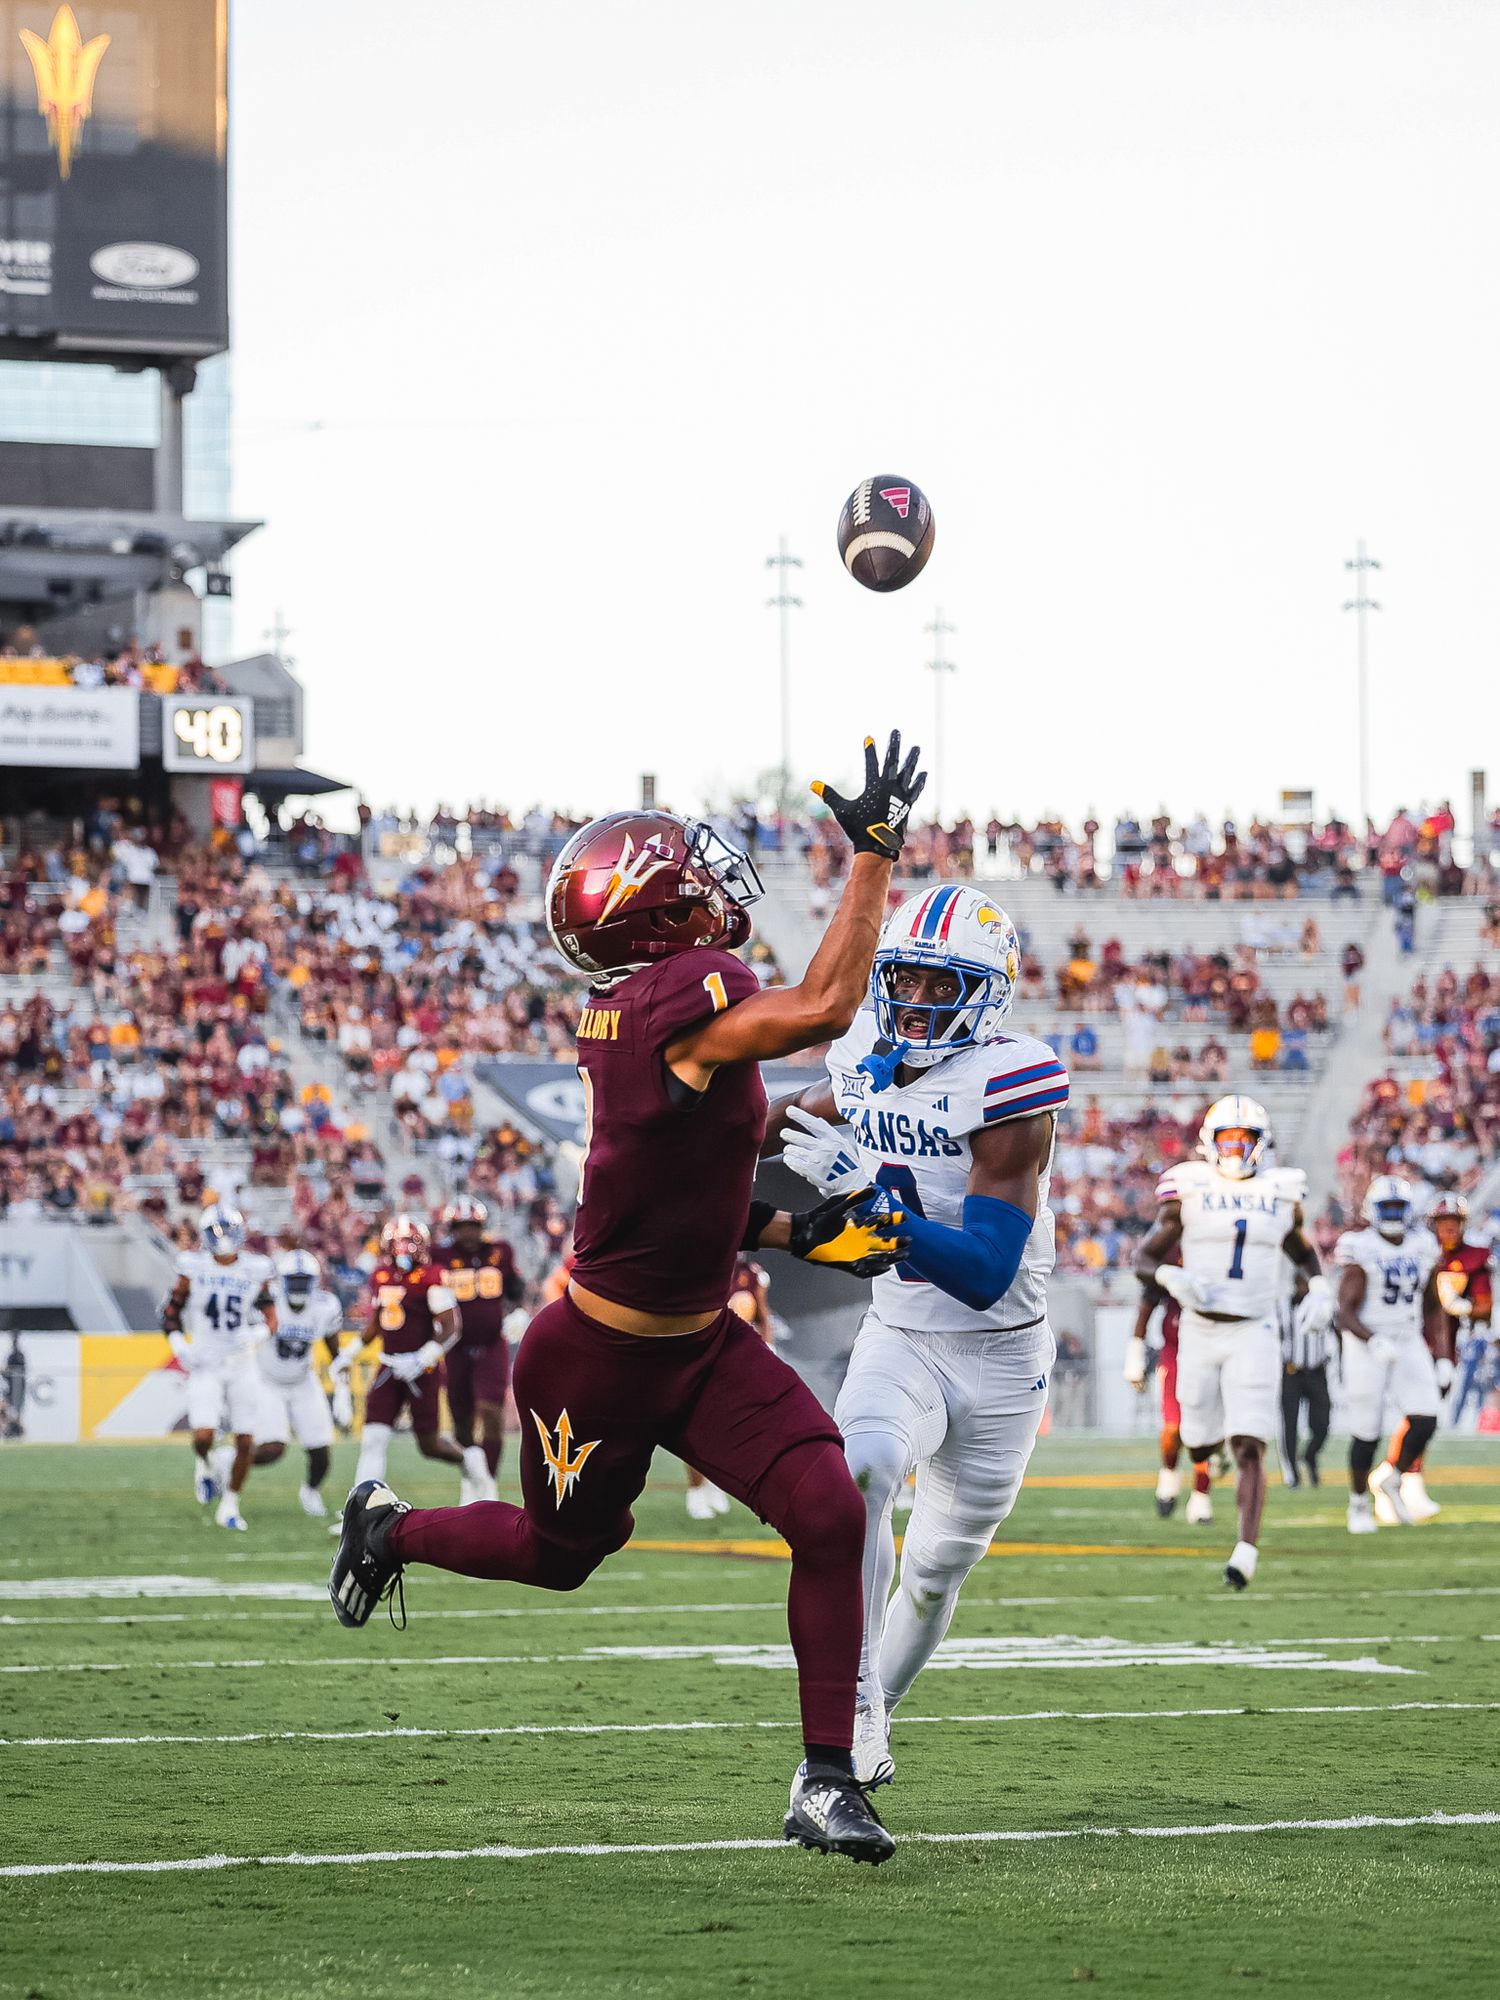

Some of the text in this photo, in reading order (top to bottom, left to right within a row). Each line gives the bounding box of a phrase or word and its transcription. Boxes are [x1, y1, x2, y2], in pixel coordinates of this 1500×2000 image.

[173, 705, 242, 763] 40
[703, 971, 728, 1013] 1
[1228, 1219, 1247, 1279] 1
[204, 1293, 242, 1331] 45
